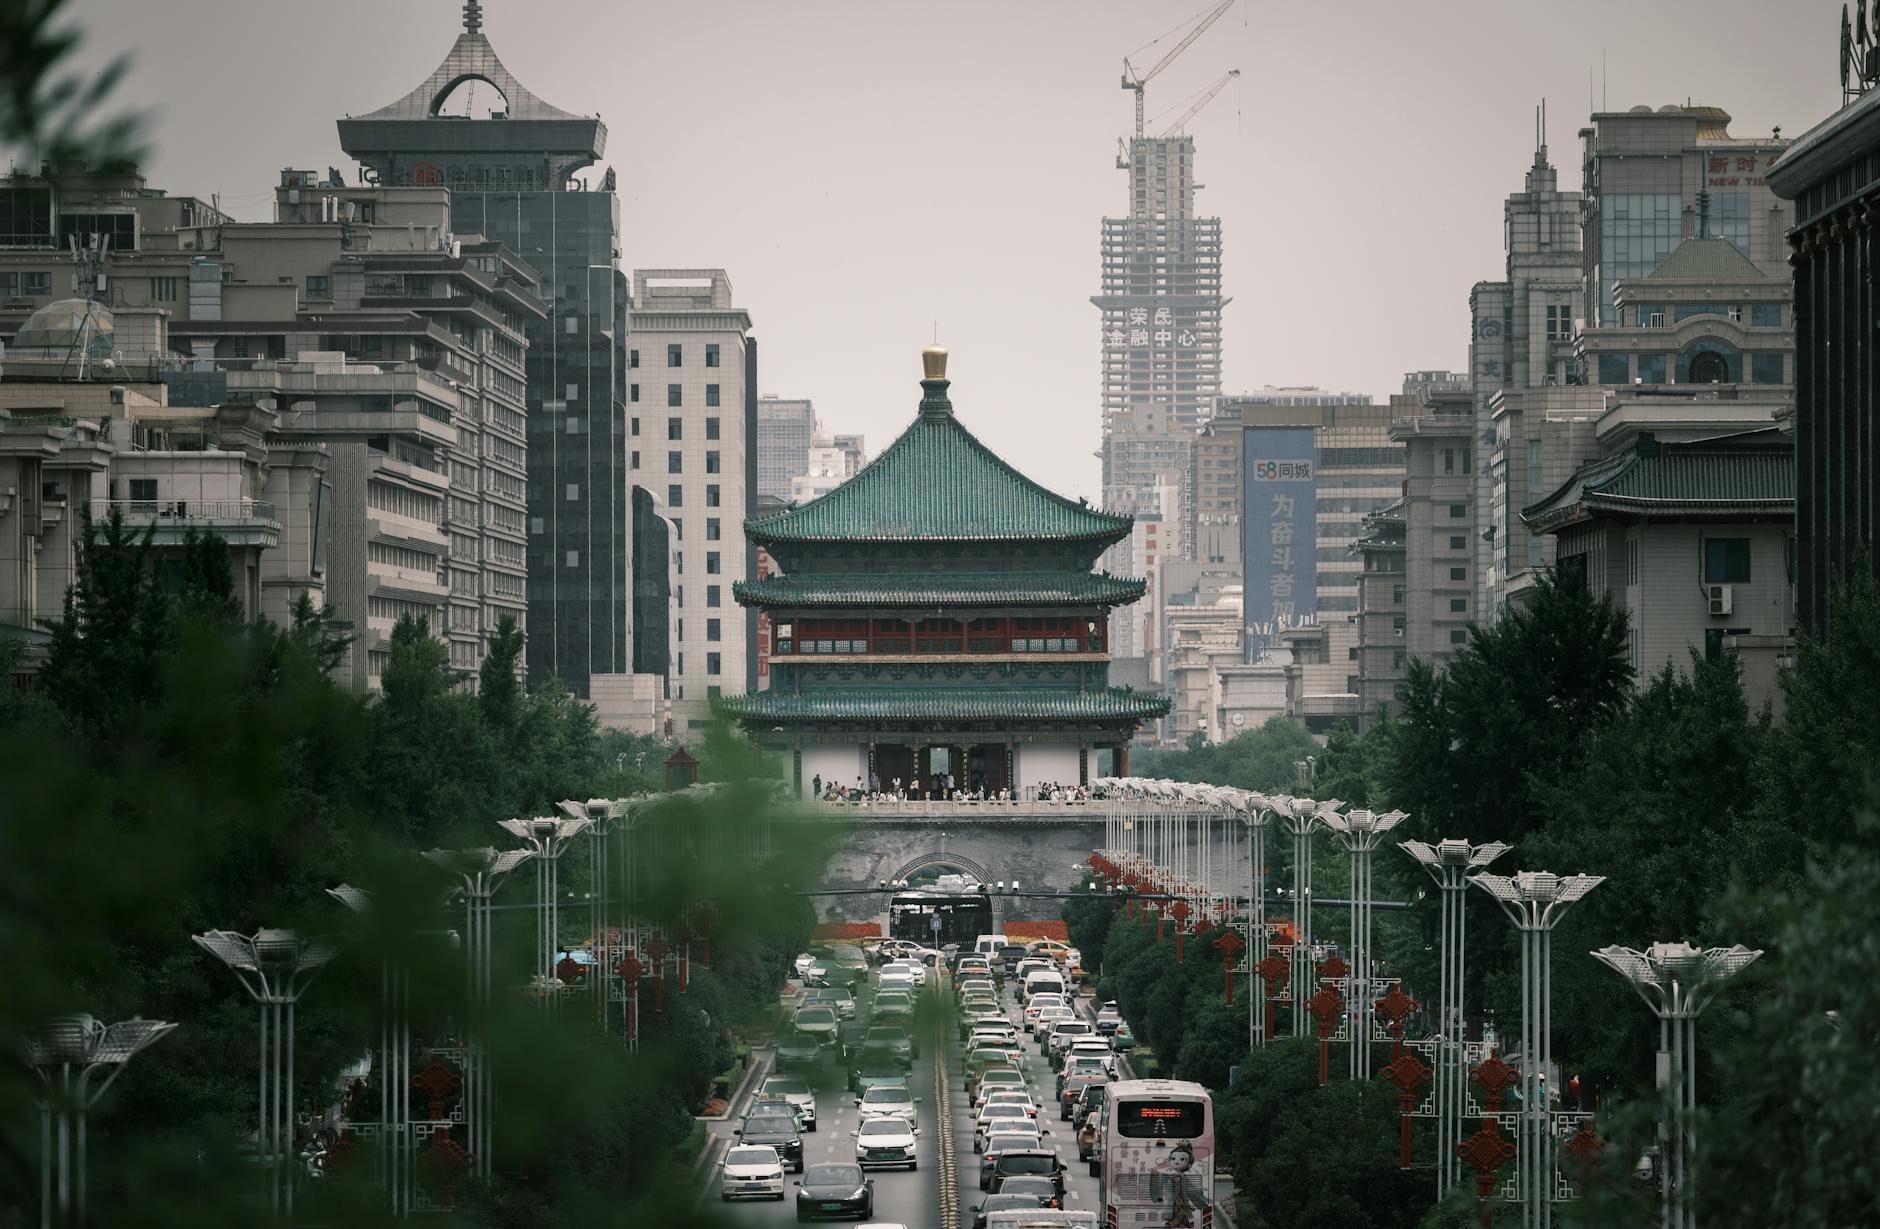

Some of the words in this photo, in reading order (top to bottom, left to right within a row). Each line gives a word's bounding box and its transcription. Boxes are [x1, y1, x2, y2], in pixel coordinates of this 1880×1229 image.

[1709, 176, 1739, 186] NEW
[1745, 176, 1770, 186] TIM
[1130, 307, 1172, 325] 荣民
[1106, 329, 1196, 347] 金融中心
[1257, 461, 1310, 480] 58同城
[1270, 493, 1295, 646] 为奋斗者加
